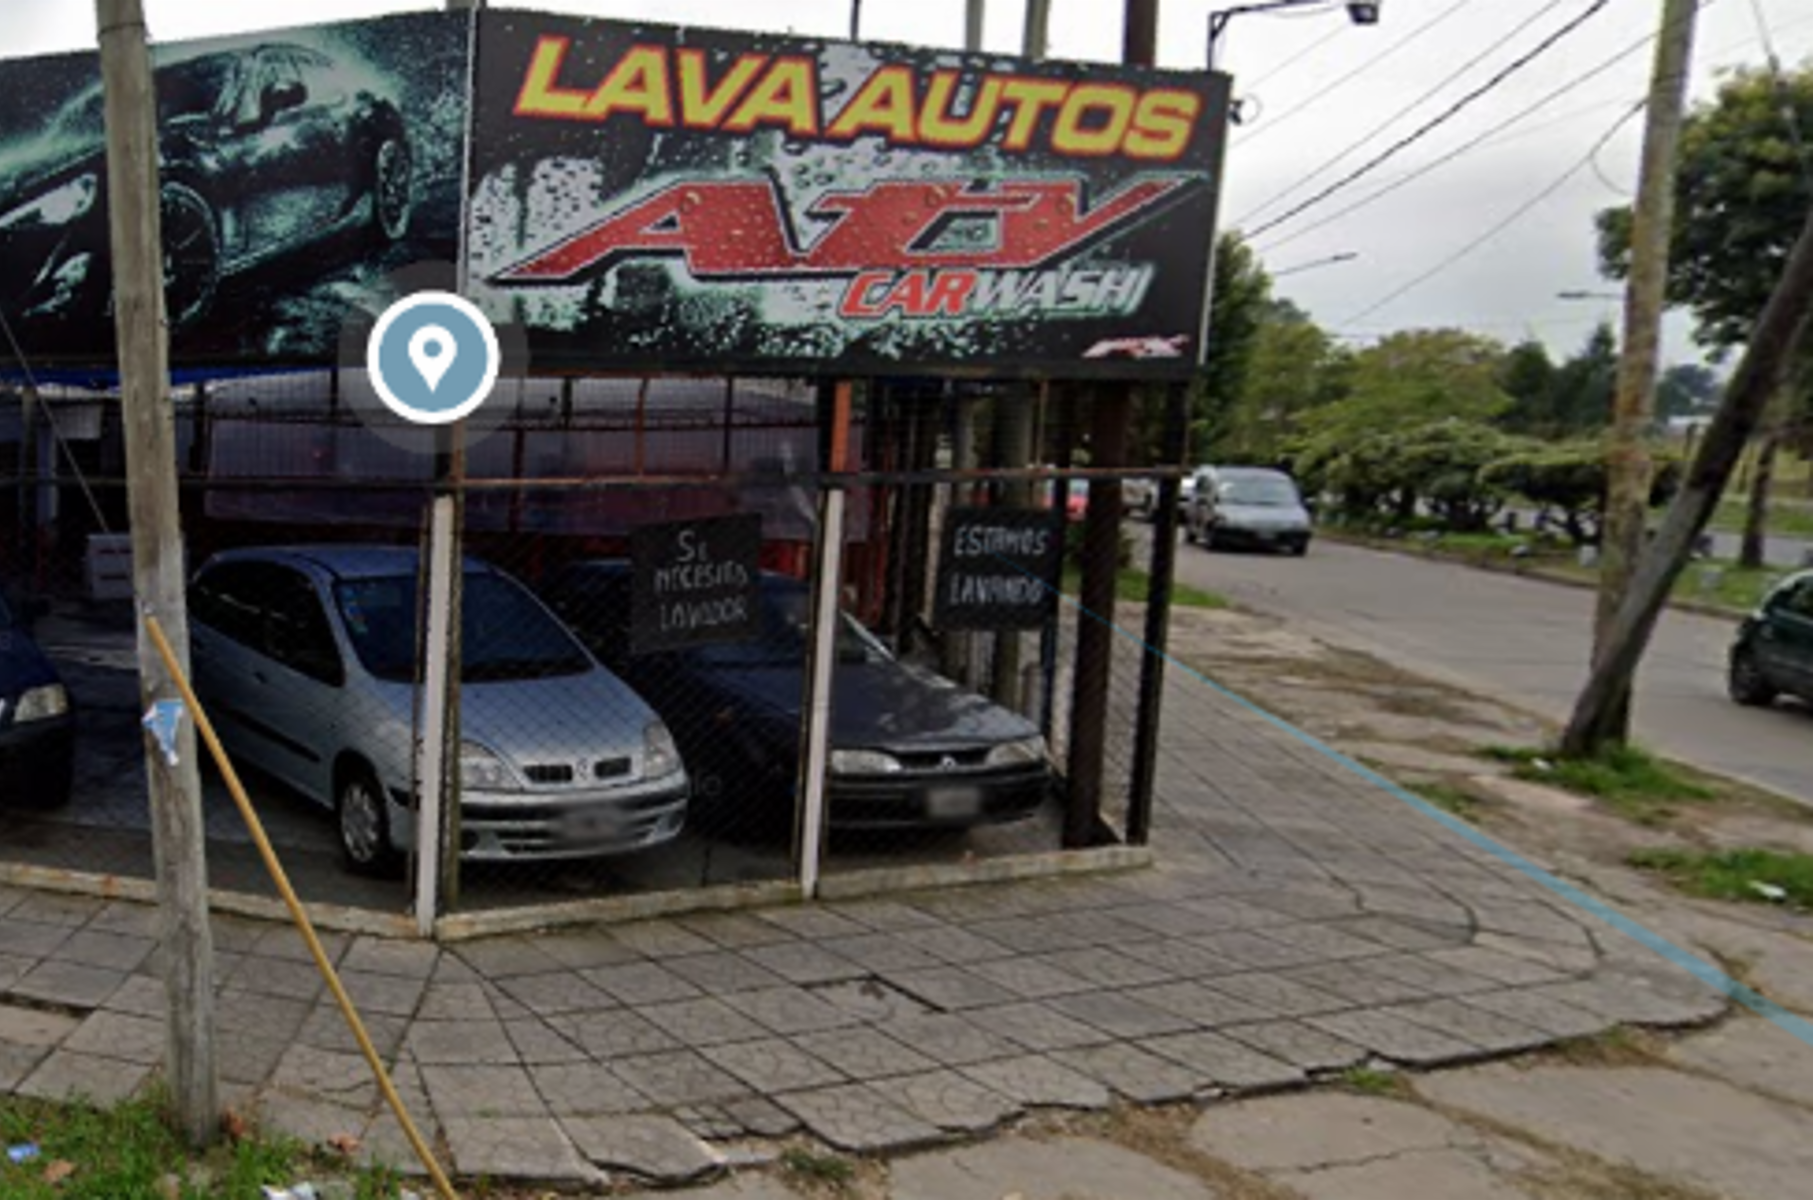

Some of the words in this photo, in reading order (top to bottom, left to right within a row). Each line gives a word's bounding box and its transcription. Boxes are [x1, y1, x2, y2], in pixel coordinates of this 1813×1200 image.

[514, 34, 823, 138] LAVA
[821, 63, 1201, 161] AUTOS
[953, 523, 1050, 558] ESTAMOS
[949, 571, 1046, 608] LAVANDO
[659, 595, 749, 633] LAVADOR
